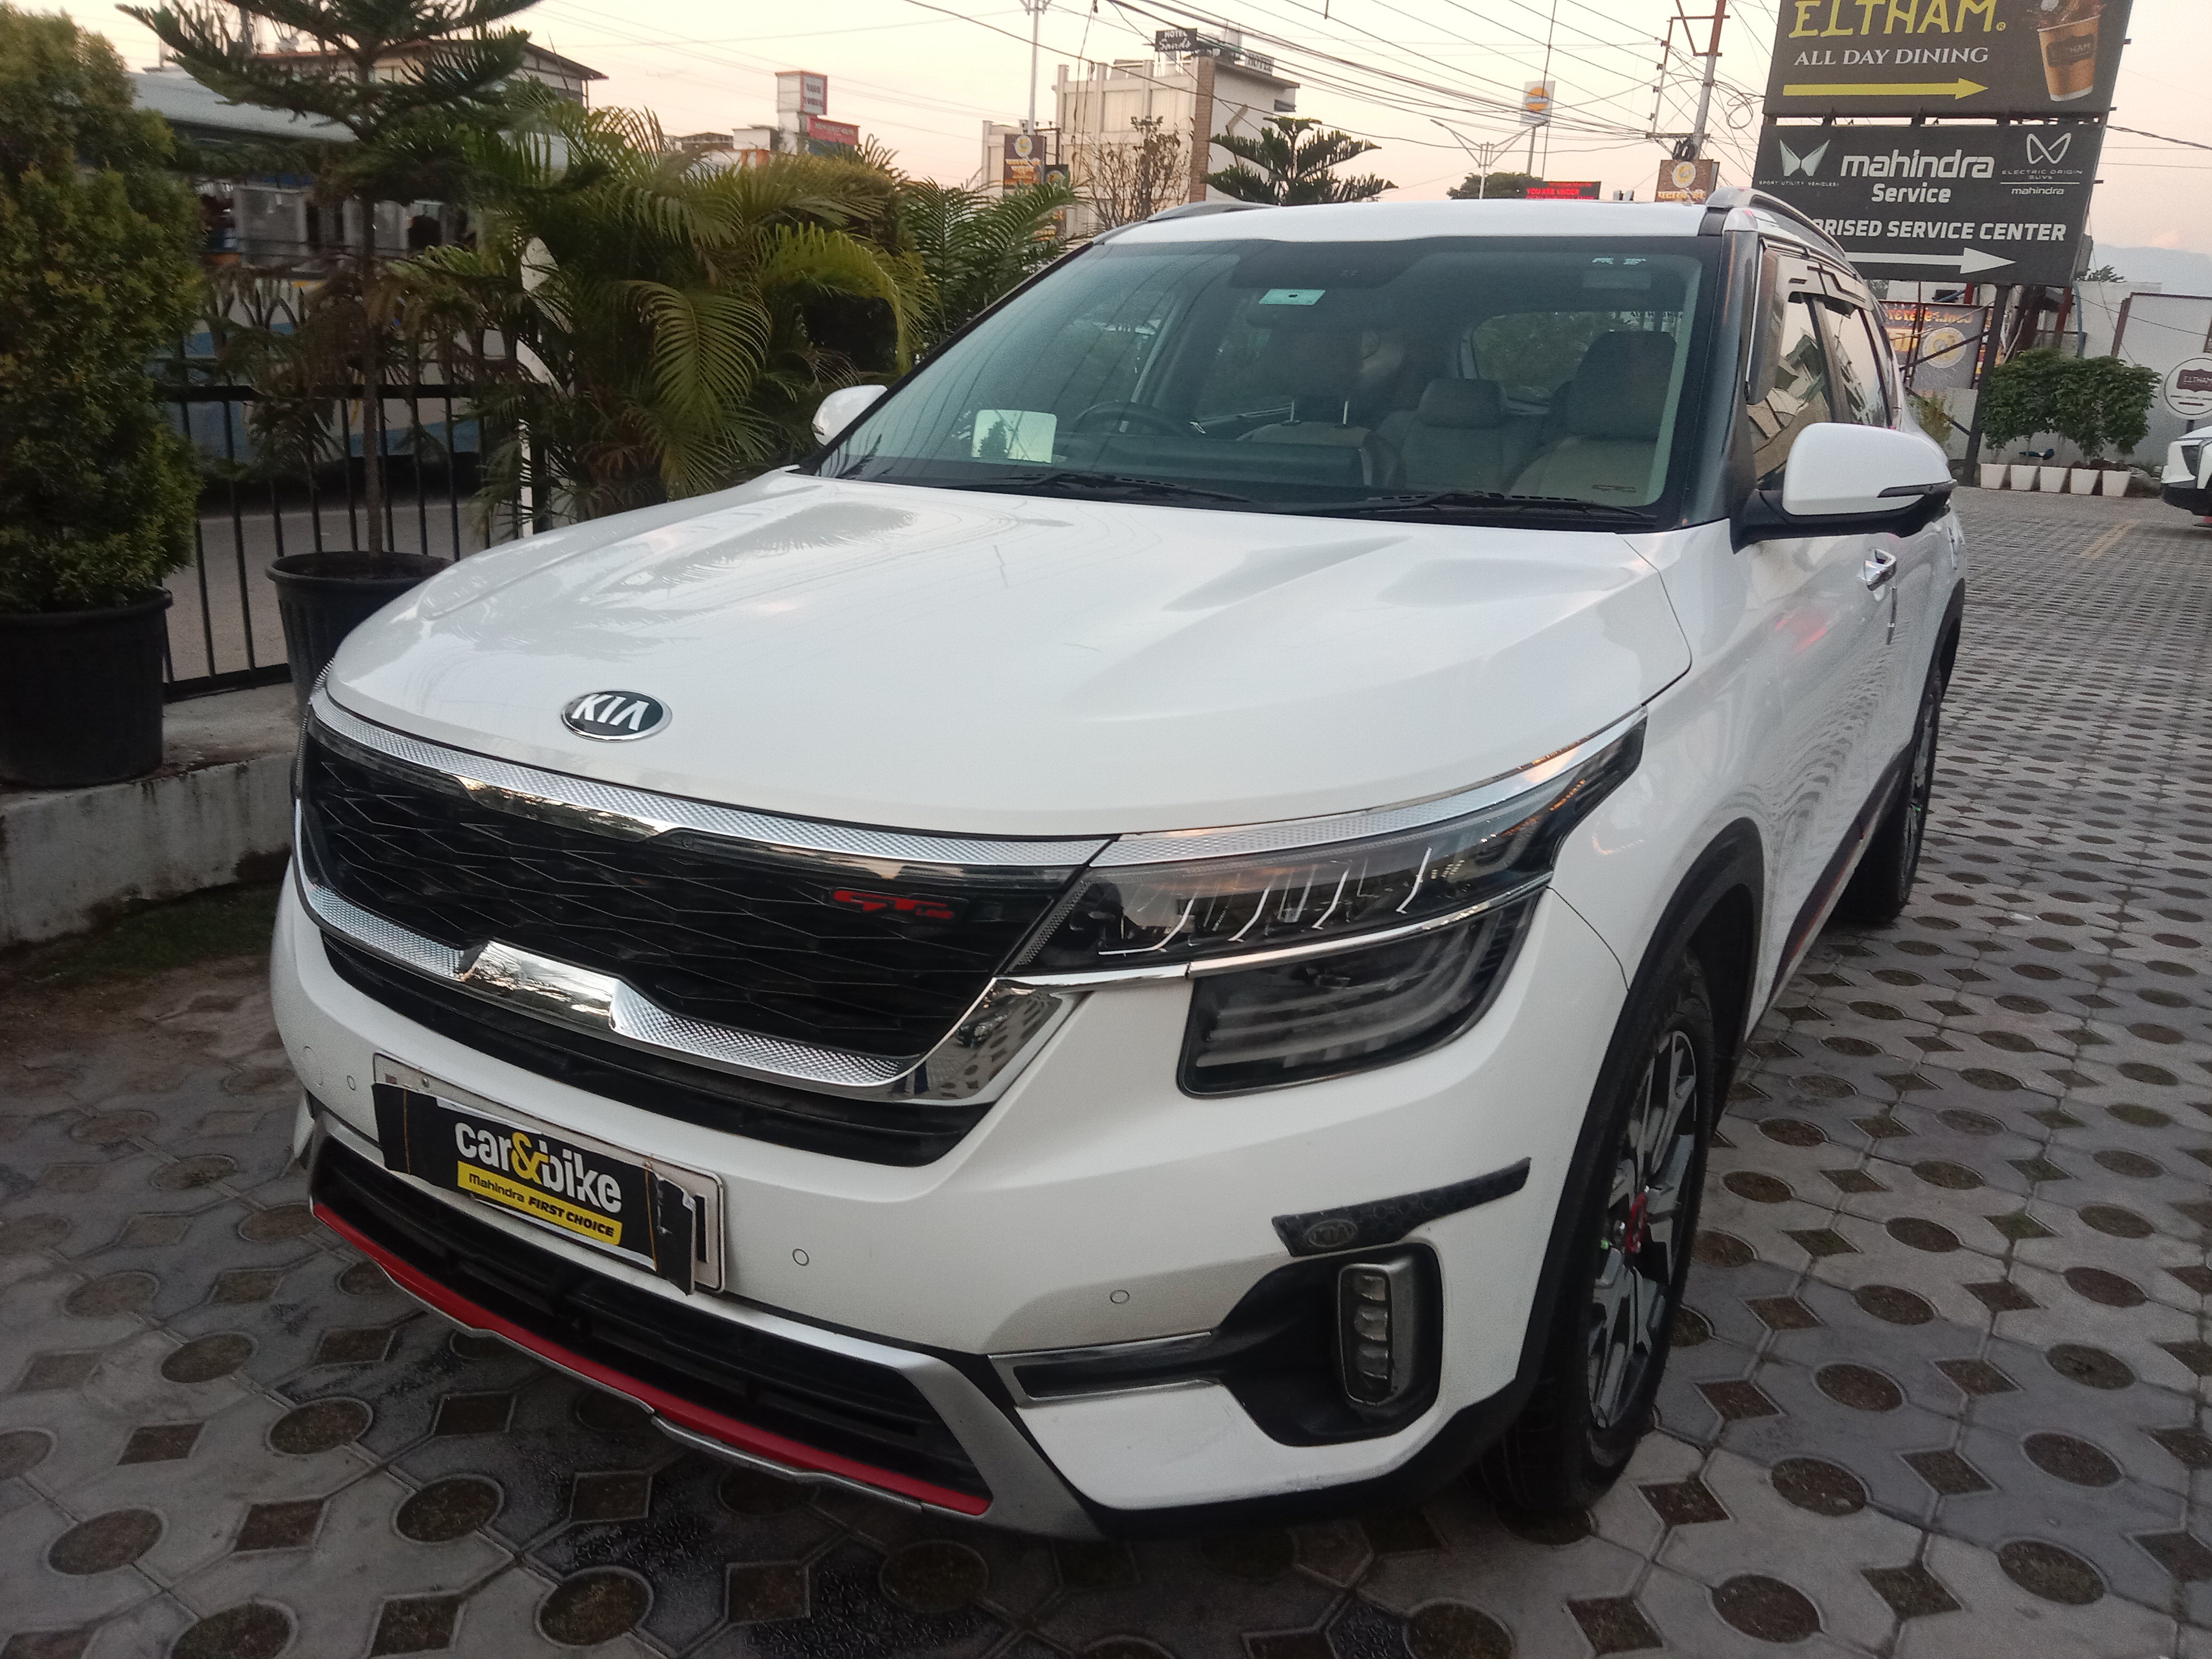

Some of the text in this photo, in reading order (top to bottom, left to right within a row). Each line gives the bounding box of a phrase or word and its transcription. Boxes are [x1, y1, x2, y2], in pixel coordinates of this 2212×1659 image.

[1788, 0, 1997, 38] ELTHAM
[1164, 29, 1188, 39] HOTEL
[1248, 53, 1272, 72] HOTEL
[1794, 47, 1989, 66] ALL DAY DINING
[1840, 149, 1995, 178] mahindra
[1871, 182, 1951, 203] Service
[2011, 187, 2065, 195] mahindra
[1886, 220, 1975, 239] SERVICE
[1979, 223, 2066, 241] CENTER
[571, 693, 650, 731] KIA
[528, 1195, 565, 1218] FIRST
[566, 1211, 615, 1238] CHOICE
